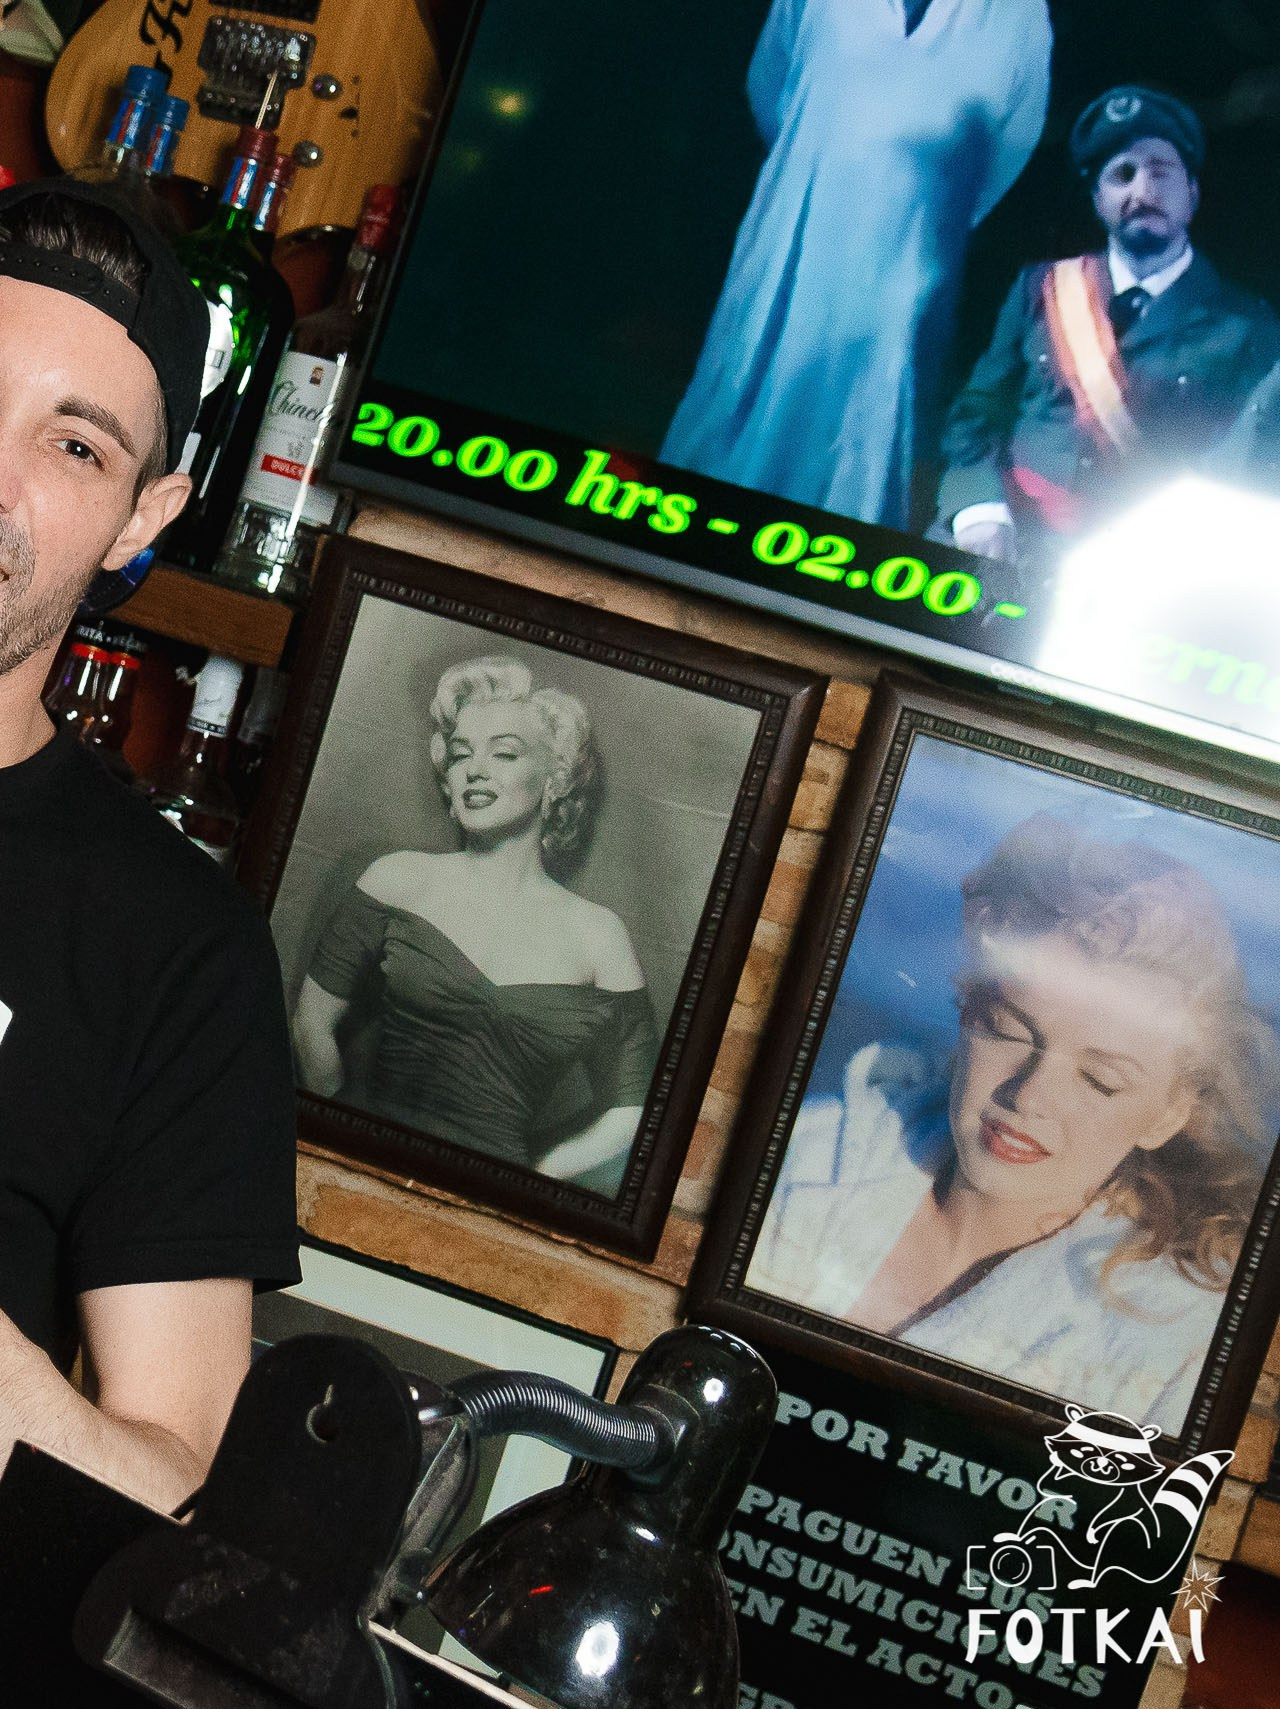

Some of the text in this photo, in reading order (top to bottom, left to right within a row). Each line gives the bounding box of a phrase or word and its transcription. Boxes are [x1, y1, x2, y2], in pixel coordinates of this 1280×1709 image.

[352, 401, 558, 493] 20.00
[566, 450, 697, 535] hrs
[751, 521, 981, 618] 02.00
[775, 1392, 1078, 1530] POR FAVOR
[720, 1528, 1107, 1698] NSUMICIOES
[736, 1484, 1054, 1625] PAGUEN SUS
[790, 1606, 857, 1658] EL
[866, 1637, 1014, 1709] ACTO
